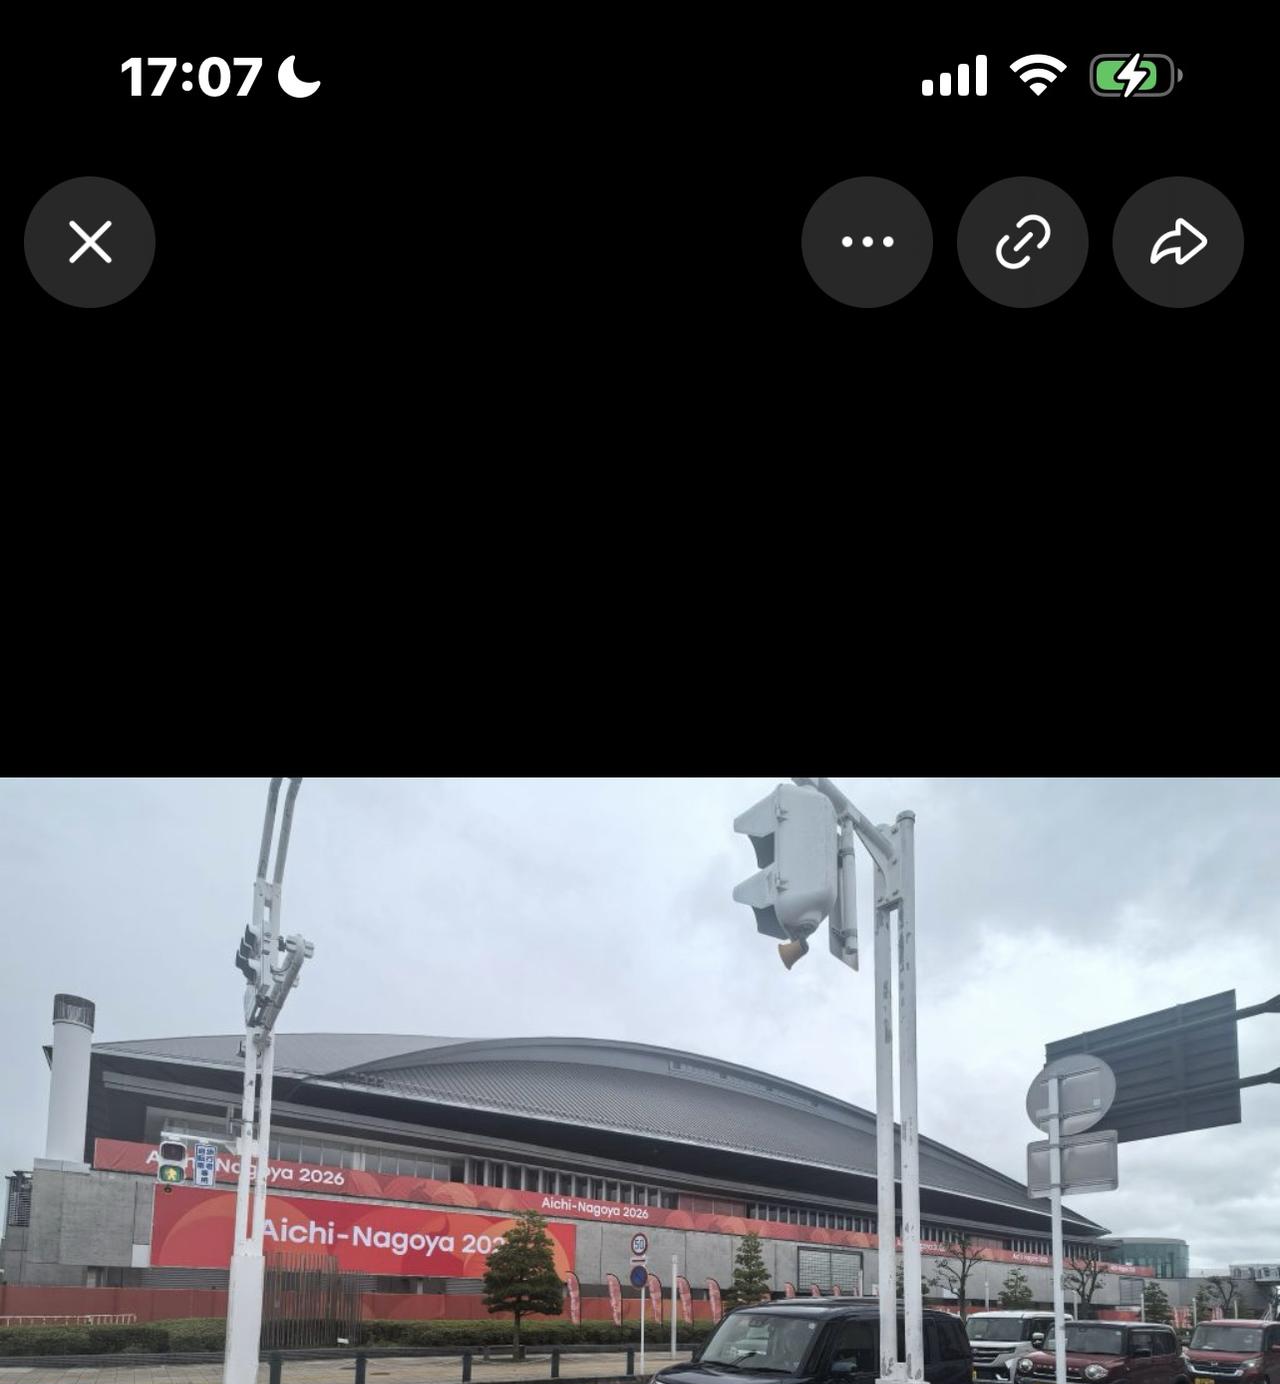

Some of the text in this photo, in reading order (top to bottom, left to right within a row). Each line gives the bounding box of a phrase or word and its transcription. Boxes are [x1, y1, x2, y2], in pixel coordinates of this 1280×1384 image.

[299, 1168, 345, 1186] 2026
[541, 1196, 649, 1220] Aichi-Nagoya 2026
[262, 1217, 507, 1257] Aichi-Nagoya 202
[634, 1239, 646, 1250] 50
